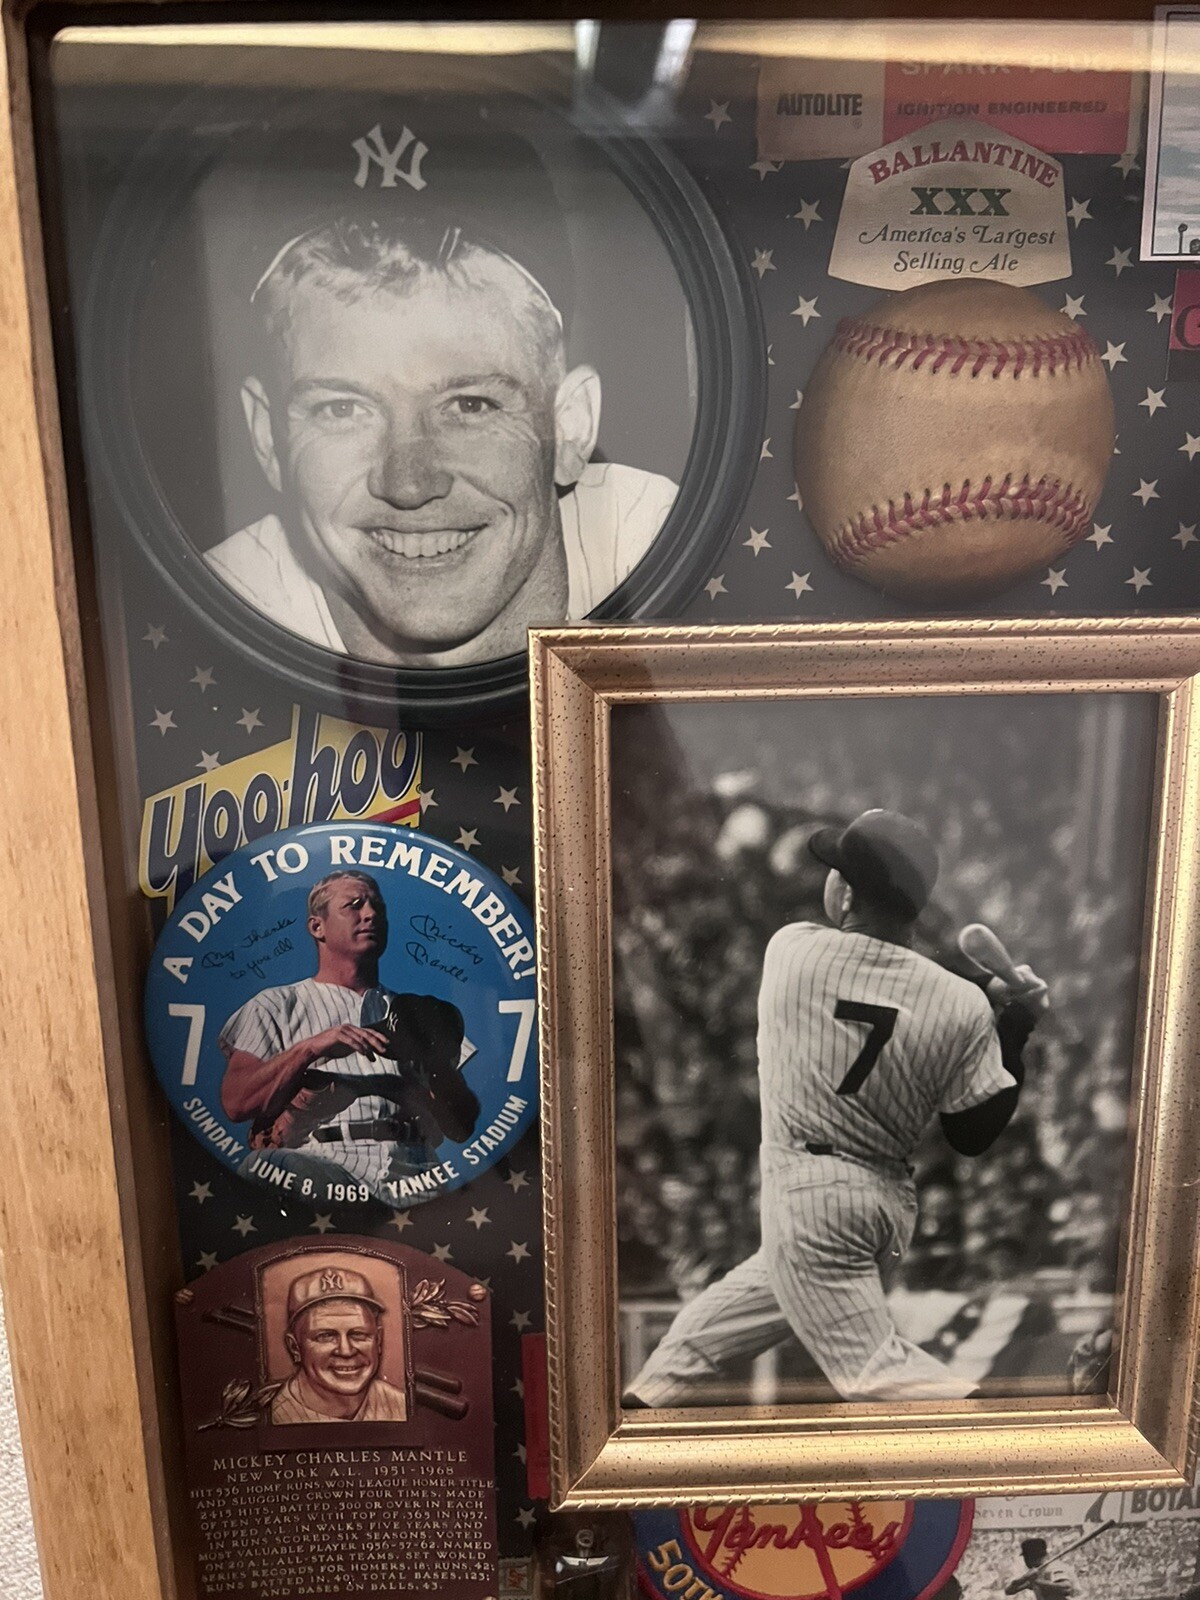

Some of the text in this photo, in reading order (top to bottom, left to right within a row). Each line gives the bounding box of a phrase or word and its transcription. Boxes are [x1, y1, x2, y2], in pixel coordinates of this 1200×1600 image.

[776, 93, 863, 116] AUTOLITE
[896, 101, 1108, 115] IGNITION ENGINEERED
[868, 139, 1059, 188] BALLANTINE
[909, 187, 1013, 217] XXX
[858, 224, 1056, 249] America's Largest
[893, 250, 1019, 274] Selling Ale
[164, 835, 534, 984] A DAY TO REMEMBER!
[168, 1003, 206, 1086] 7
[498, 998, 536, 1082] 7
[833, 999, 899, 1095] 7
[183, 1093, 529, 1202] SUNDAY, JUNE 8, 1969 YANKEE STADIUM
[213, 1450, 468, 1471] MICKEY CHARLES MANTLE
[227, 1471, 263, 1483] NEW
[273, 1468, 319, 1480] YORK
[329, 1466, 362, 1477] A.L.
[246, 1484, 281, 1494] HOME
[324, 1479, 355, 1488] WON
[359, 1479, 408, 1488] LEAGUE
[412, 1479, 455, 1487] HOMER
[459, 1479, 494, 1488] TITLE
[197, 1499, 226, 1509] AND
[232, 1493, 300, 1506] SLUGGING
[306, 1490, 354, 1500] CROWN
[359, 1490, 393, 1498] FOUR
[446, 1490, 485, 1498] MADE
[280, 1502, 330, 1513] BATTED
[365, 1501, 382, 1509] OR
[386, 1501, 421, 1509] OVER
[426, 1500, 440, 1508] IN
[447, 1501, 483, 1509] EACH
[1131, 1488, 1200, 1514] BOTA
[201, 1521, 217, 1531] OF
[221, 1518, 249, 1528] TEN
[255, 1515, 300, 1525] YEARS
[307, 1513, 344, 1522] WITH
[352, 1512, 376, 1520] TOP
[383, 1511, 399, 1519] OF
[437, 1510, 450, 1519] IN
[205, 1528, 258, 1541] TOPPED
[316, 1521, 363, 1532] WALKS
[369, 1521, 400, 1530] FIVE
[406, 1521, 448, 1529] YEARS
[453, 1521, 483, 1529] AND
[209, 1541, 224, 1550] IN
[232, 1537, 268, 1548] RUNS
[275, 1534, 330, 1544] SCORED
[337, 1533, 359, 1541] SIX
[436, 1531, 482, 1539] VOTED
[198, 1551, 232, 1562] MOST
[237, 1545, 304, 1557] VALUABLE
[309, 1542, 357, 1552] PLAYER
[443, 1541, 492, 1549] NAMED
[205, 1562, 224, 1572] ON
[436, 1551, 486, 1560] WORLD
[202, 1572, 247, 1583] SERIES
[252, 1566, 314, 1577] RECORDS
[320, 1564, 345, 1573] FOR
[206, 1582, 244, 1593] RUNS
[250, 1576, 304, 1588] BATTED
[362, 1573, 406, 1581] TOTAL
[261, 1588, 290, 1597] AND
[298, 1584, 340, 1594] BASES
[345, 1583, 364, 1592] ON
